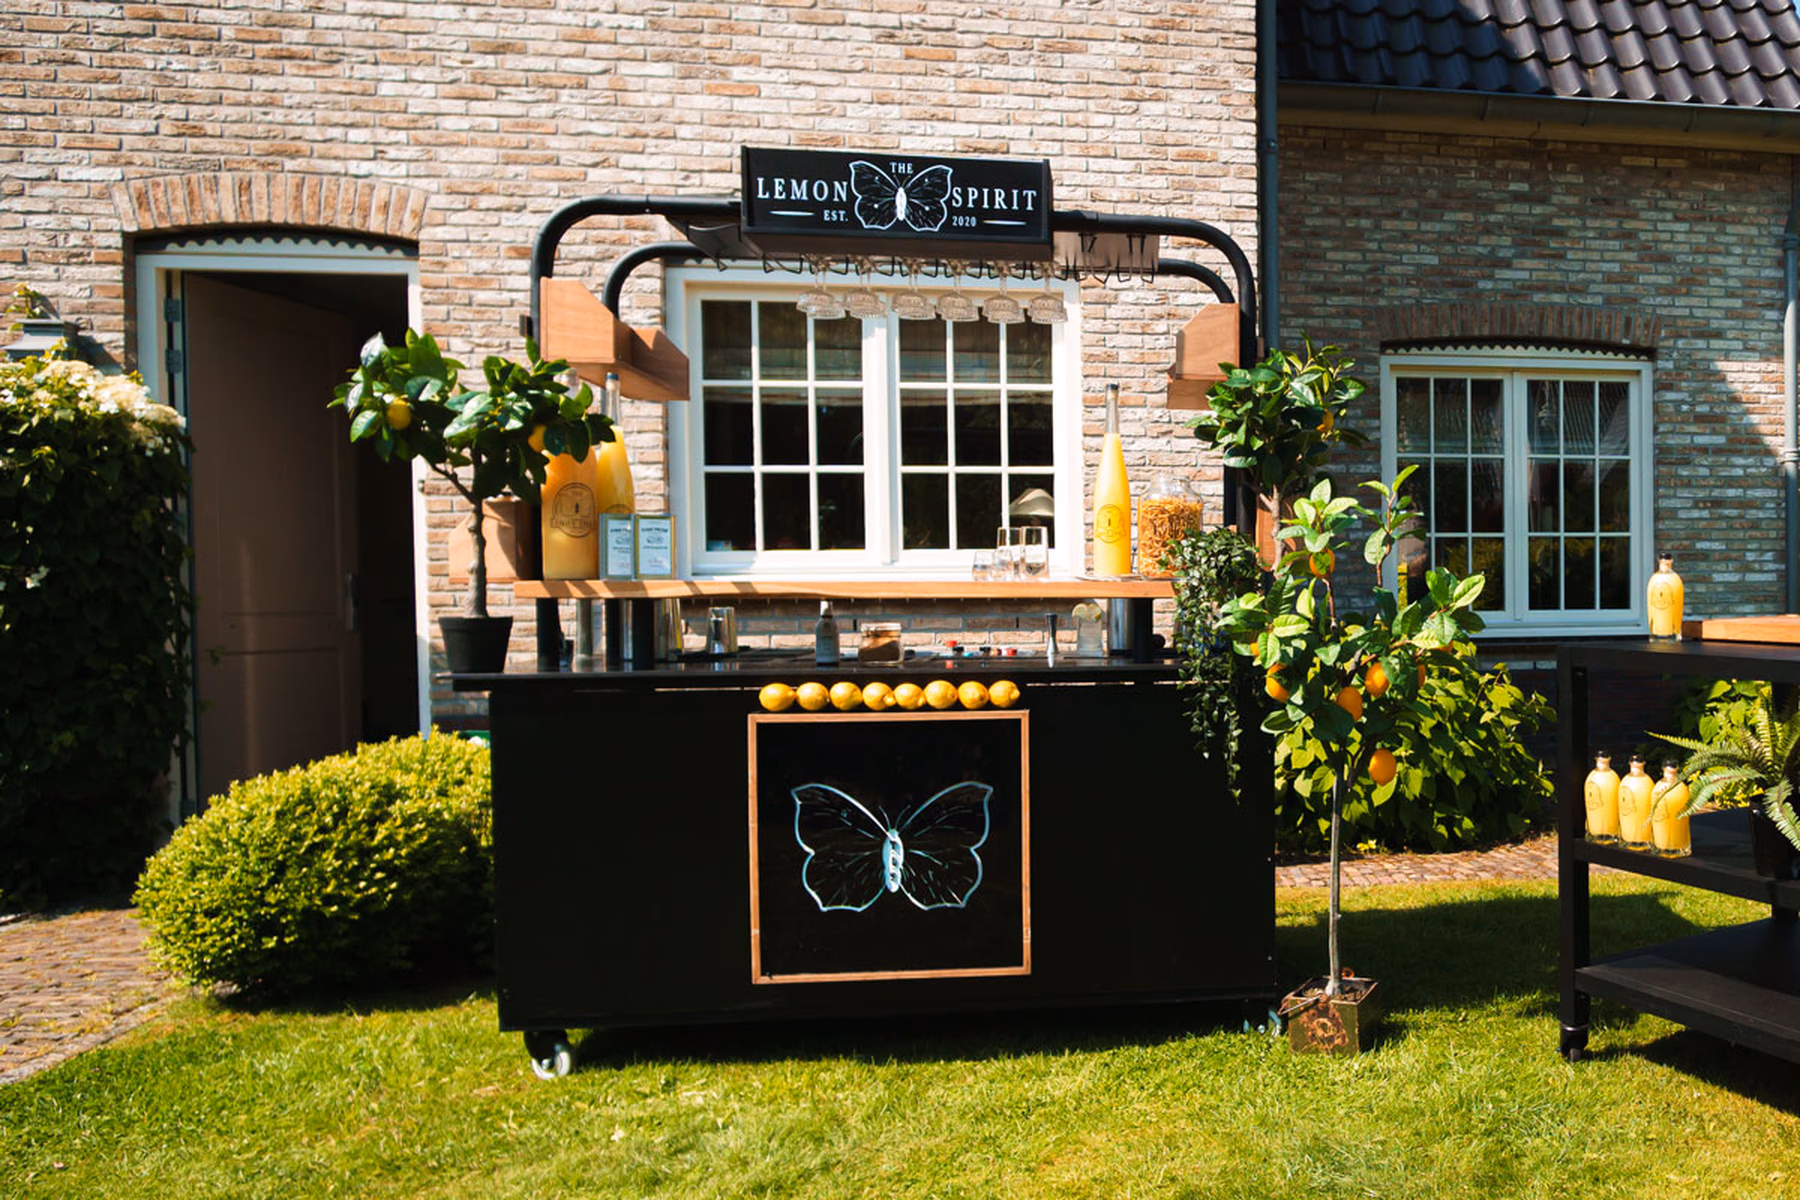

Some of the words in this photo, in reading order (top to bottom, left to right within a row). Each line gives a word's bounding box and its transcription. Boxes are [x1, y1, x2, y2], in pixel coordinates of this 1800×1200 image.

[890, 162, 914, 174] THE
[757, 177, 848, 202] LEMON
[952, 187, 1037, 211] SPIRIT
[823, 209, 848, 222] EST.
[952, 215, 977, 227] 2020
